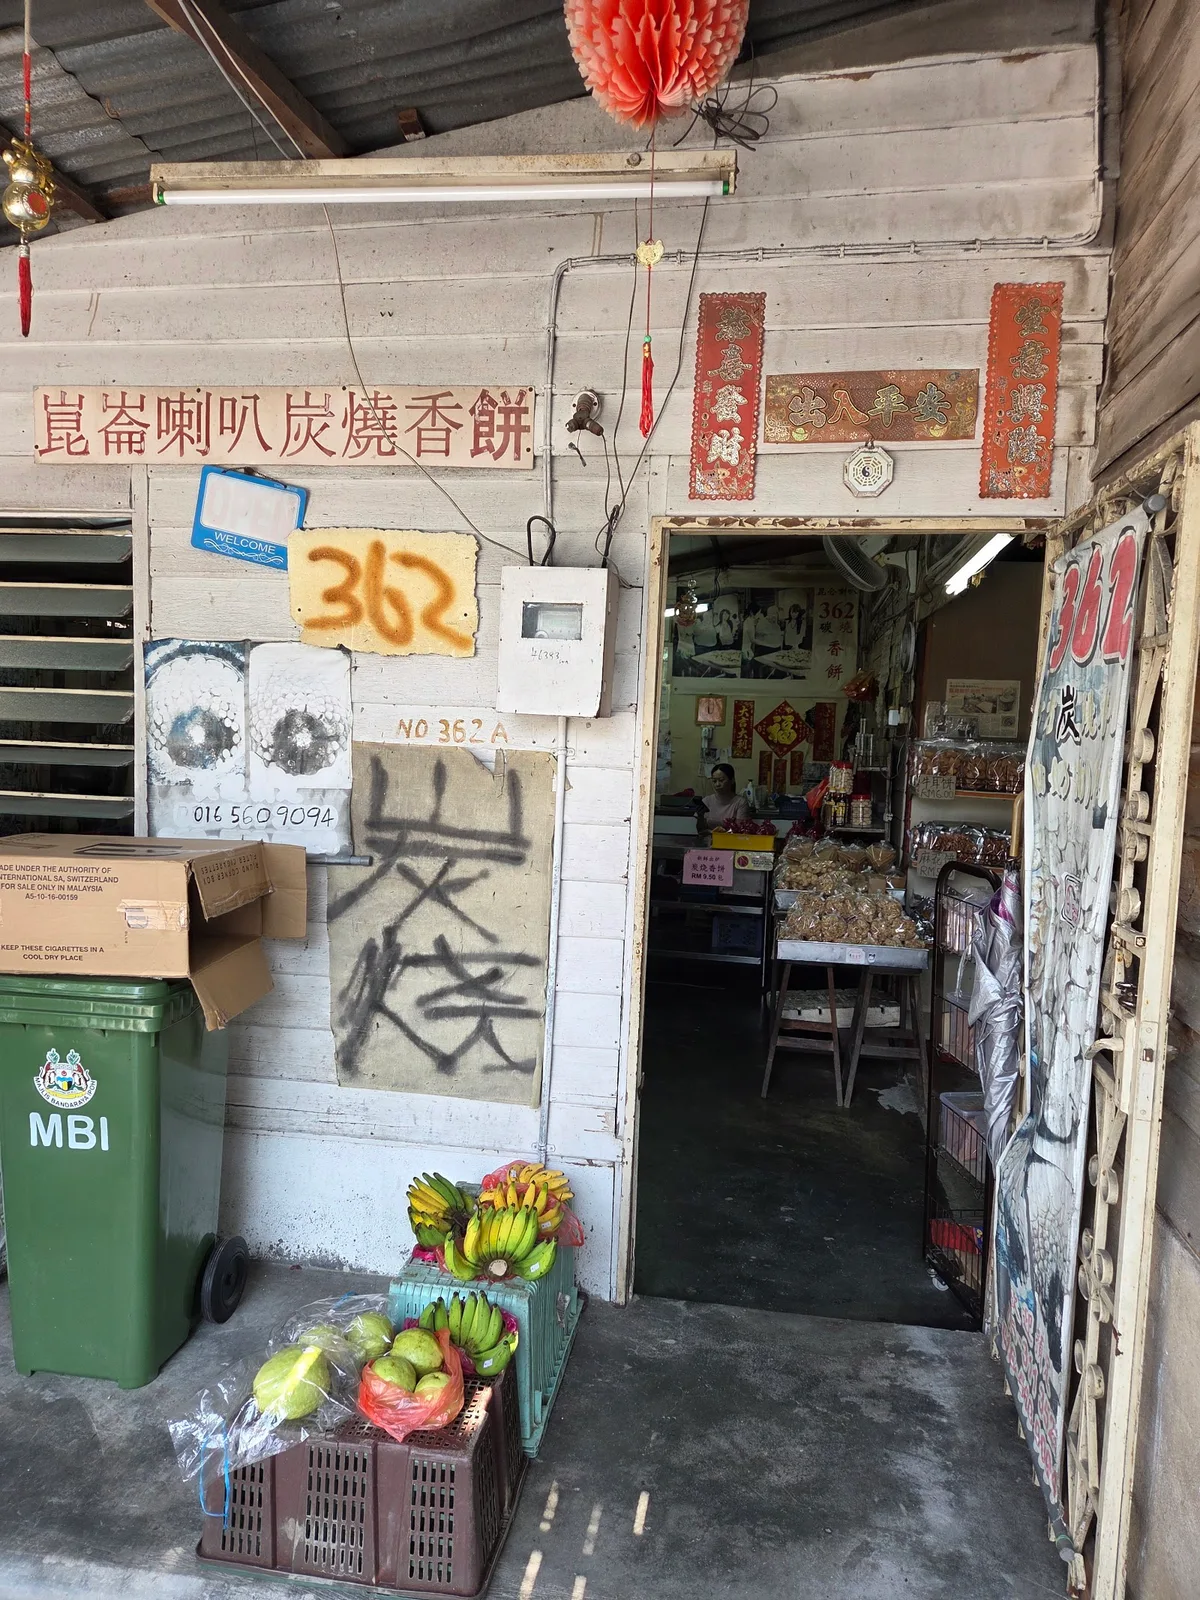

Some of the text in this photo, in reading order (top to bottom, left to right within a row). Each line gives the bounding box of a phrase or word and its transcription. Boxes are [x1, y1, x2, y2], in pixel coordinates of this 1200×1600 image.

[787, 382, 952, 428] 出入平安
[214, 531, 276, 555] WELCOME
[302, 541, 474, 648] 362
[1049, 525, 1137, 674] 362
[819, 602, 854, 619] 362
[398, 718, 509, 744] NO 362 A
[736, 705, 750, 750] 大吉大利
[767, 715, 797, 745] 福
[194, 806, 222, 823] 016
[45, 945, 88, 953] CIGARETTES
[35, 1077, 51, 1100] MAJLIS
[50, 1095, 90, 1108] BANDARAYA
[29, 1112, 109, 1151] MBI
